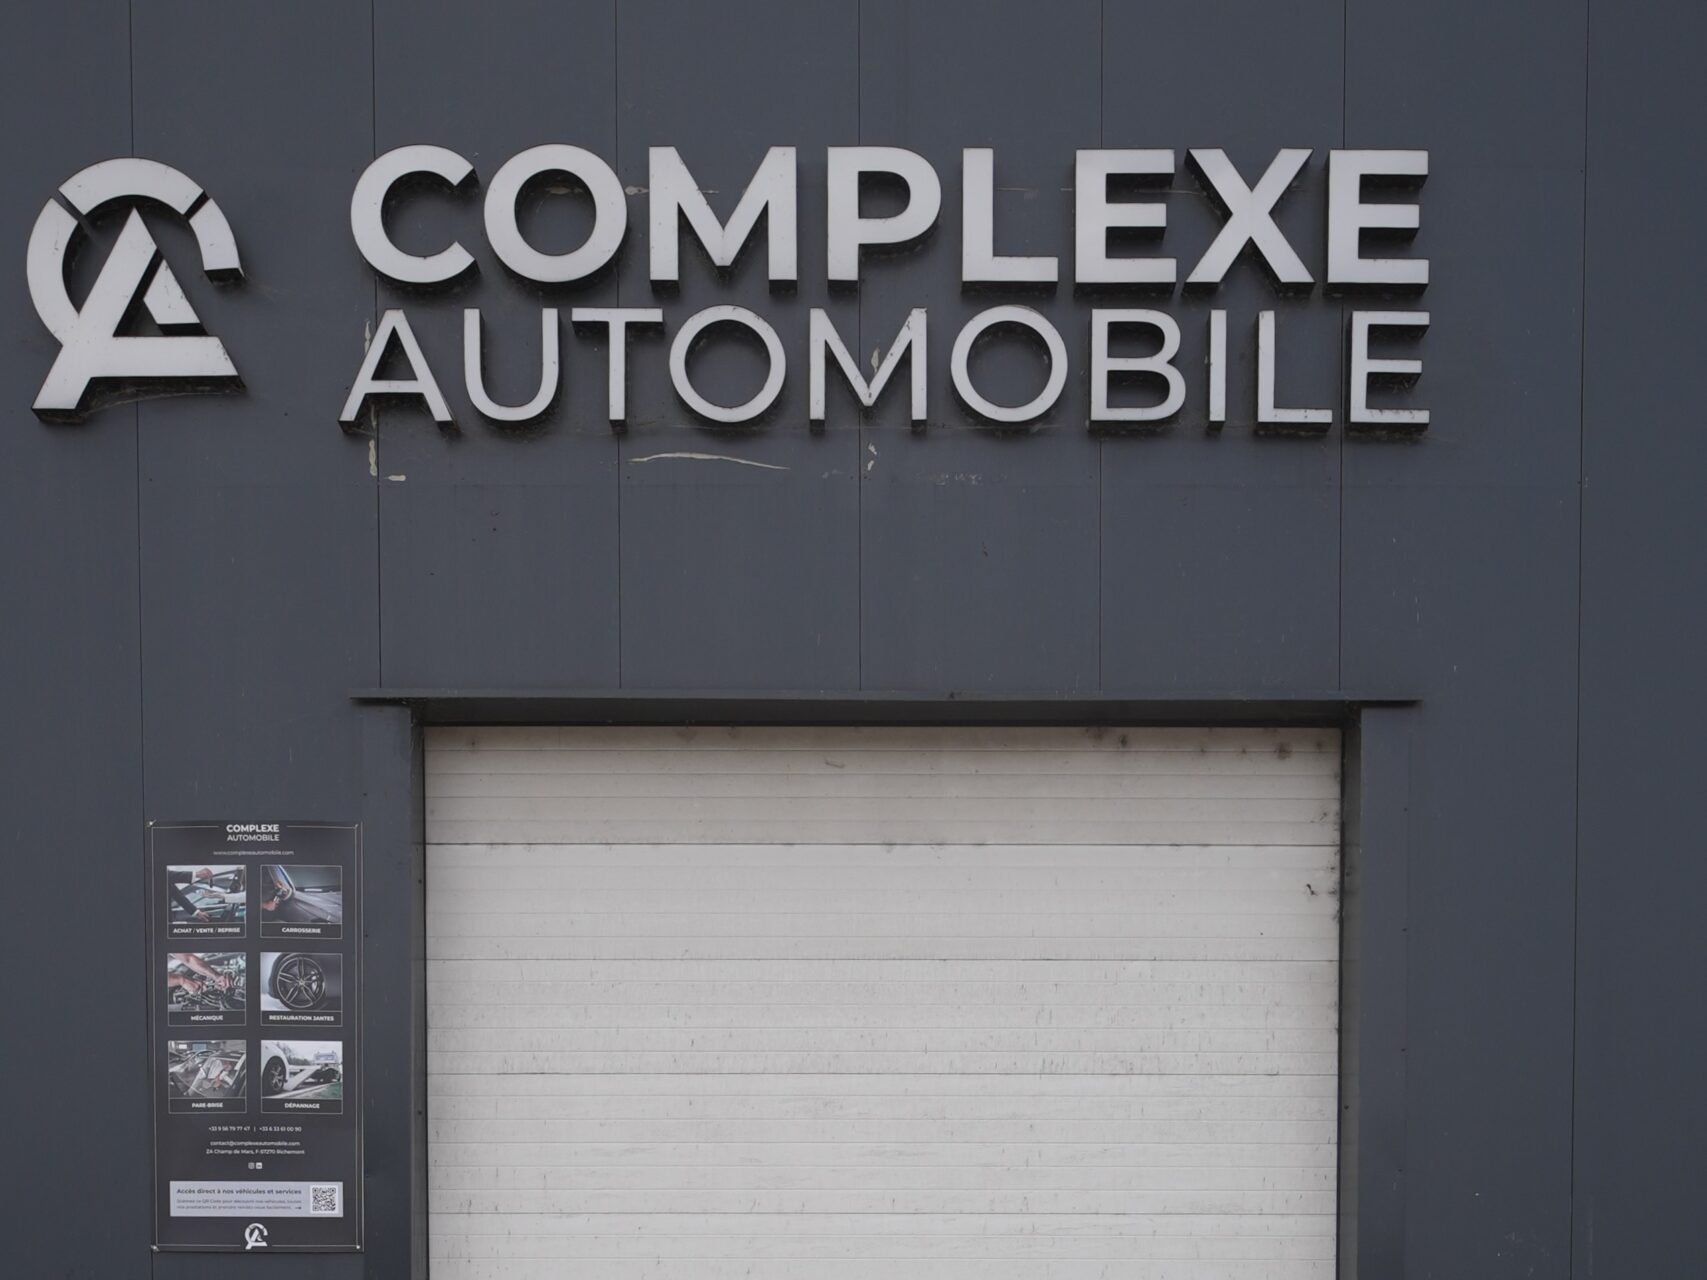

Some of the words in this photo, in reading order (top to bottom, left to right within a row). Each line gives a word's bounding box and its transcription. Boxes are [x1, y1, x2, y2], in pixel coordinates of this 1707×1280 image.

[350, 144, 1431, 290] COMPLEXE
[338, 304, 1431, 432] AUTOMOBILE
[226, 824, 280, 833] COMPLEXE
[226, 834, 280, 842] AUTOMOBILE
